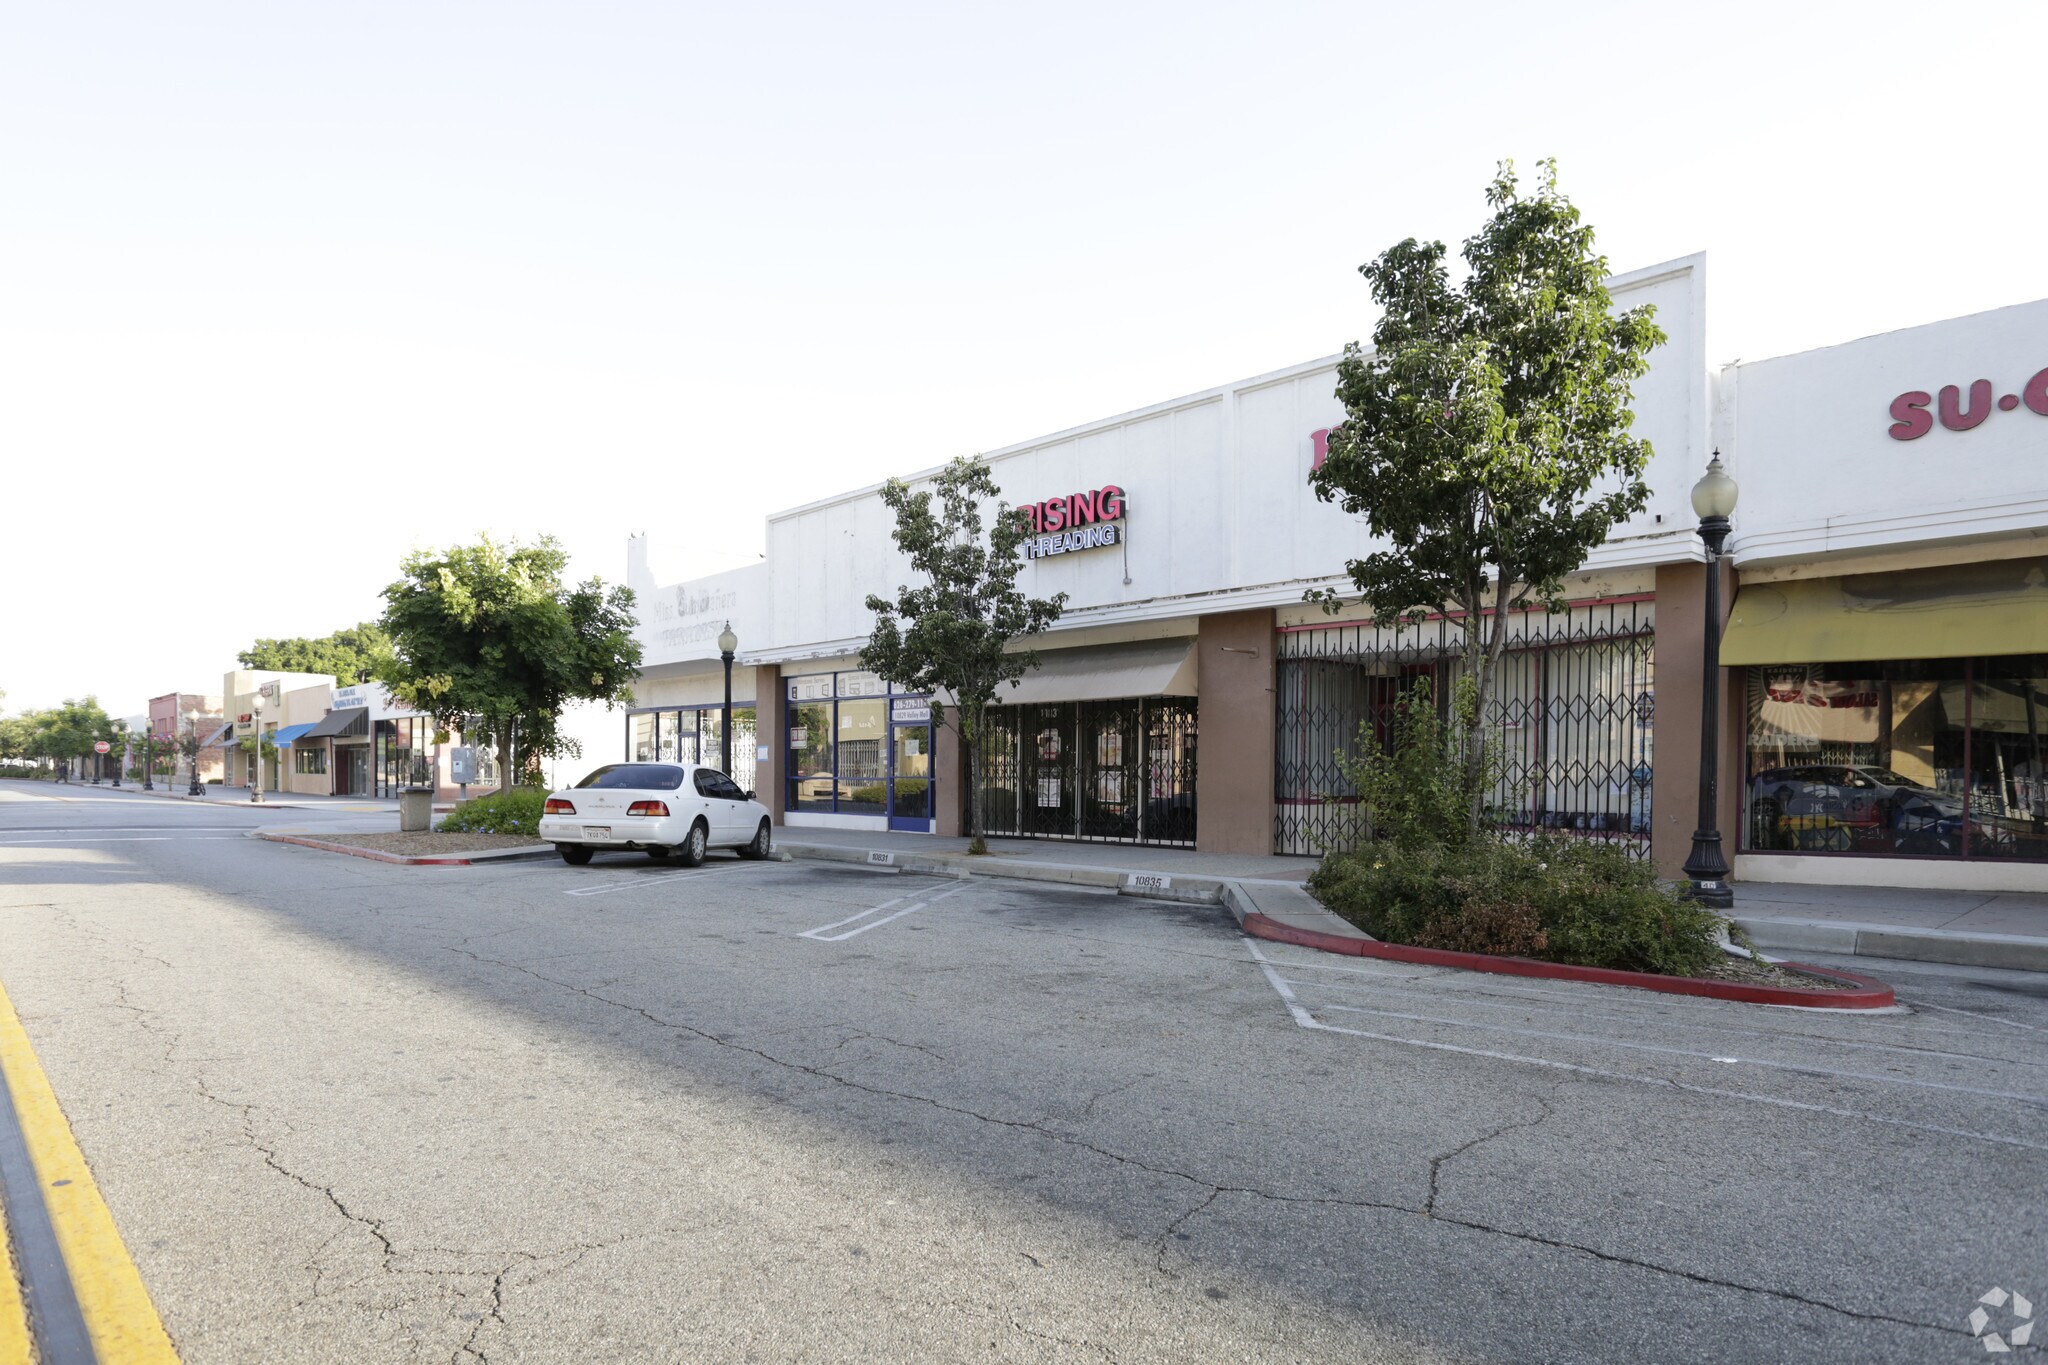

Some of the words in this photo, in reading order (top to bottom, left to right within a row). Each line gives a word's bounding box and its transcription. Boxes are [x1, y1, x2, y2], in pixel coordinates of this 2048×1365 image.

[1017, 485, 1121, 533] RISING
[1021, 525, 1115, 560] THREADING
[1747, 734, 1819, 746] RAIDERS
[872, 852, 889, 862] 10831
[1135, 875, 1162, 887] 10835
